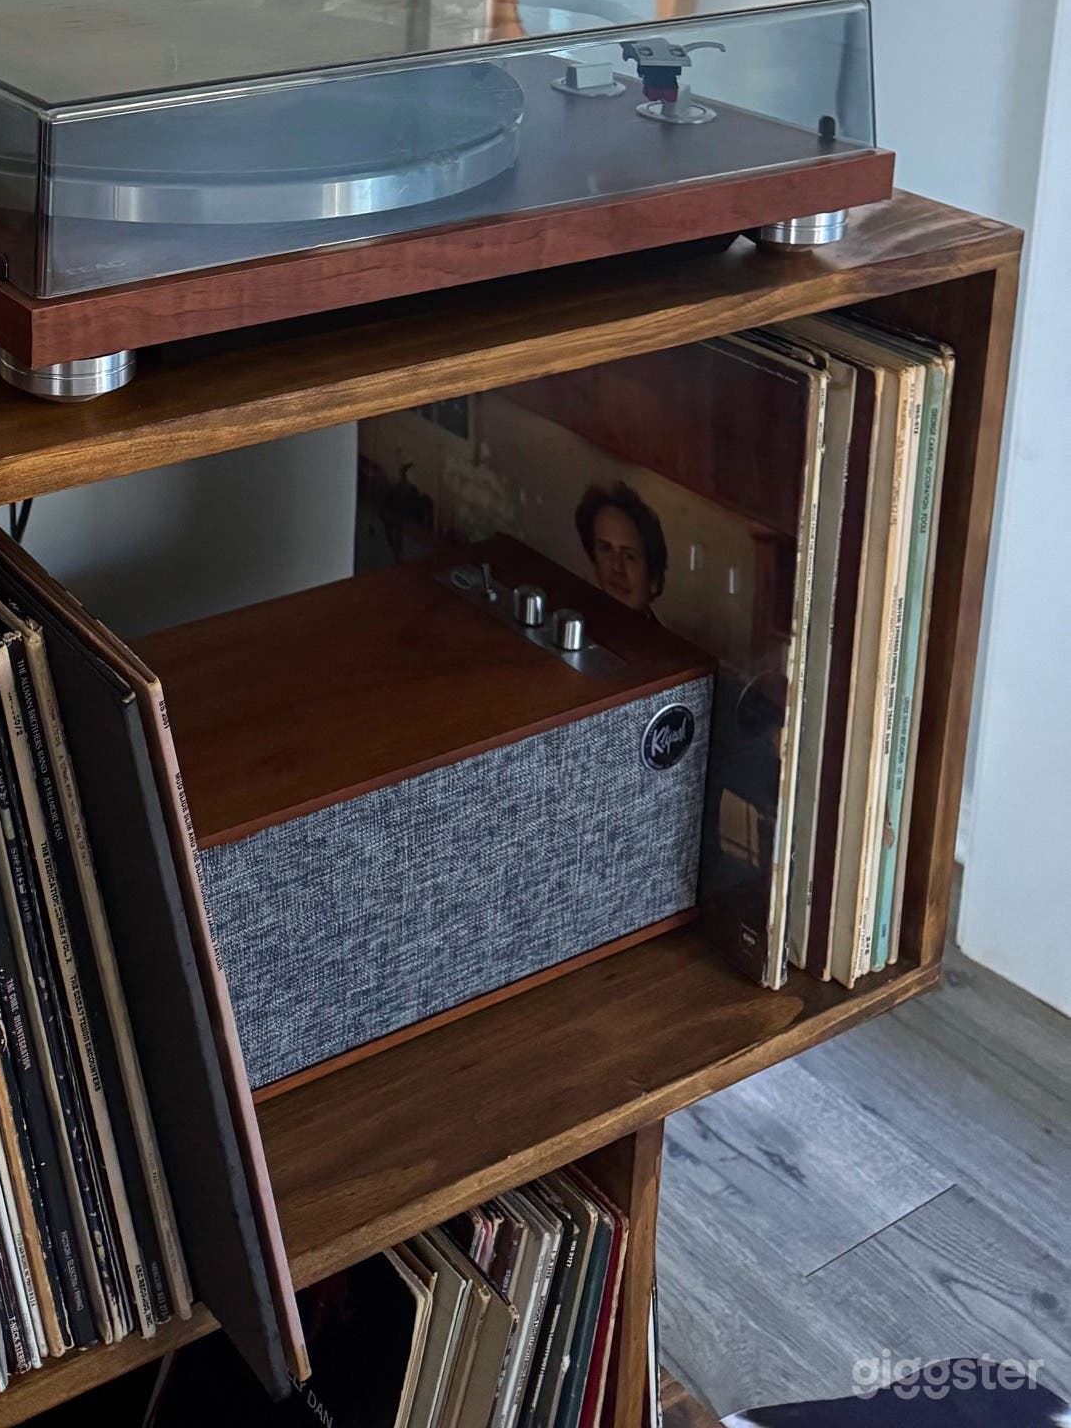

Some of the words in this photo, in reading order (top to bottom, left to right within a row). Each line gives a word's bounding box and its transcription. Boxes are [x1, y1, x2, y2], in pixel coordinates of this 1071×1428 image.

[16, 659, 26, 675] THE
[20, 676, 34, 709] ALLMAN
[27, 708, 43, 750] BROTHERS
[36, 750, 48, 773] BAND
[42, 776, 51, 786] AT
[44, 786, 59, 822] FILLMORE
[178, 792, 189, 813] SLIDE
[53, 823, 63, 842] EAST
[183, 814, 193, 831] SLIM
[39, 840, 49, 857] THE
[187, 832, 196, 847] AND
[191, 849, 200, 862] THE
[194, 863, 204, 883] BLUE
[5, 978, 15, 992] THE
[69, 974, 79, 991] THE
[8, 993, 19, 1013] CURE
[73, 990, 85, 1016] GREAT
[78, 1016, 91, 1043] TENOR
[11, 1014, 33, 1070] DISINTEGRATION
[84, 1042, 102, 1092] ENCOUNTERS
[7, 1315, 21, 1342] T-NECK
[307, 1390, 333, 1428] DAN
